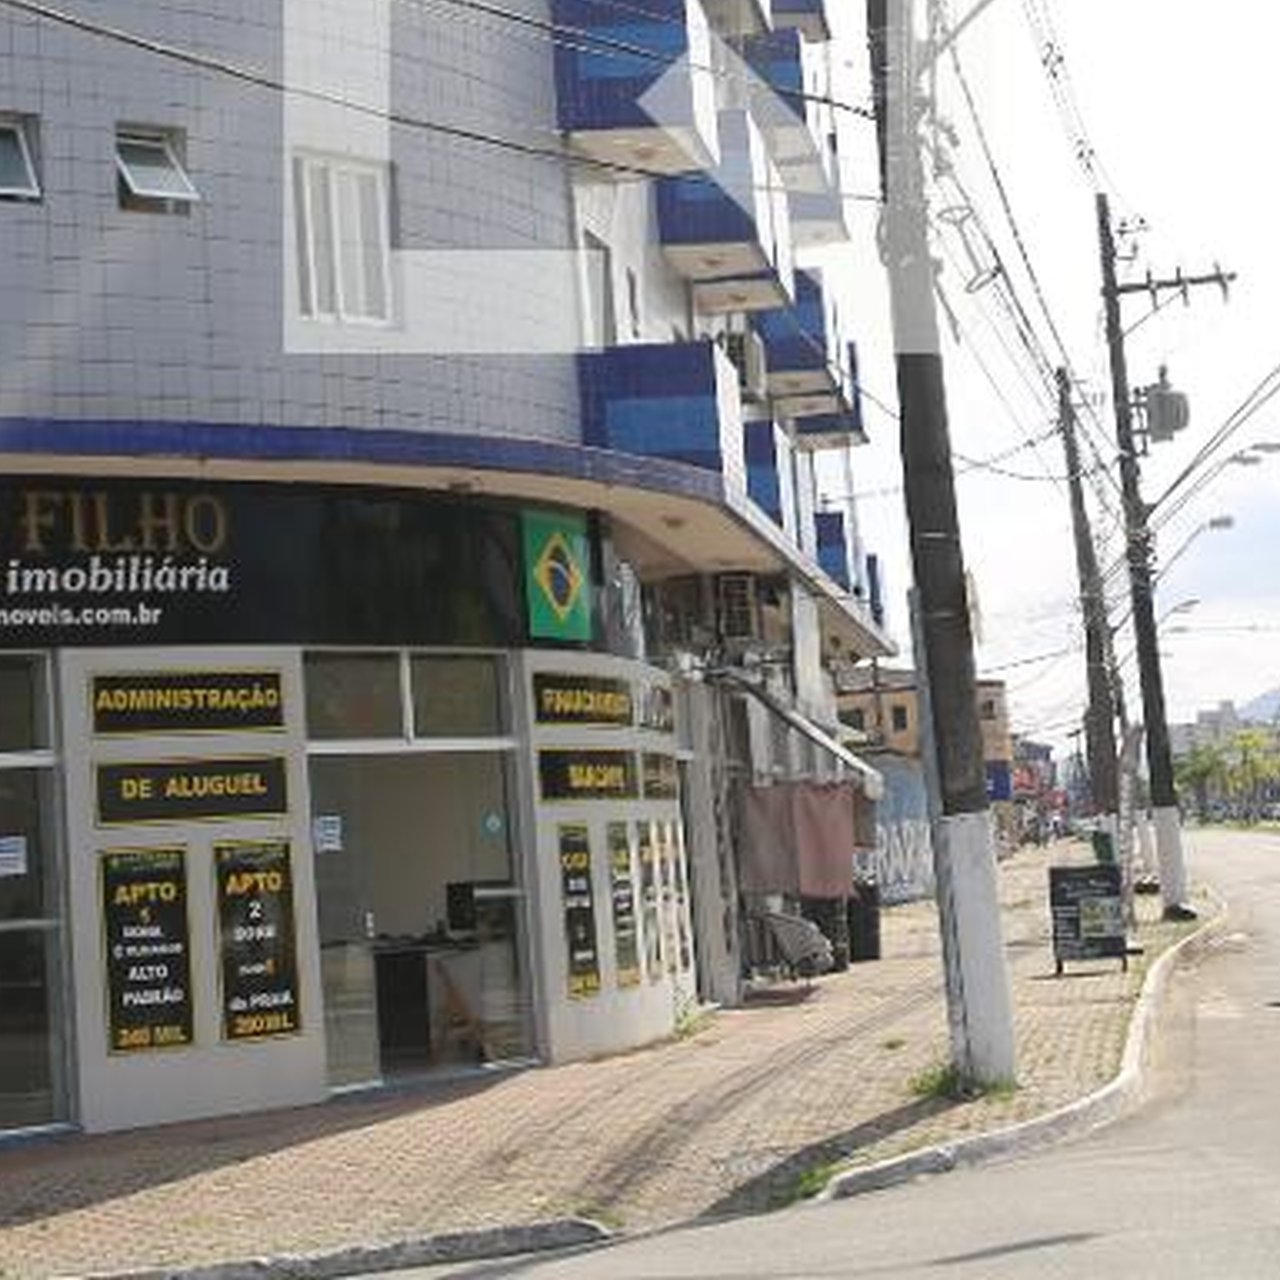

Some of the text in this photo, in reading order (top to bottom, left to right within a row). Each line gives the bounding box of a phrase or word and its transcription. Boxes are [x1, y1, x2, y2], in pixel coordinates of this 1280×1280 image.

[22, 493, 227, 555] FILHO
[5, 556, 230, 594] imobiliária
[97, 683, 278, 714] ADMINISTRAÇÃO
[122, 772, 267, 799] DE ALUGUEL
[114, 883, 176, 904] APTO
[226, 872, 282, 895] APTO
[248, 901, 261, 919] 2
[128, 964, 168, 981] ALTO
